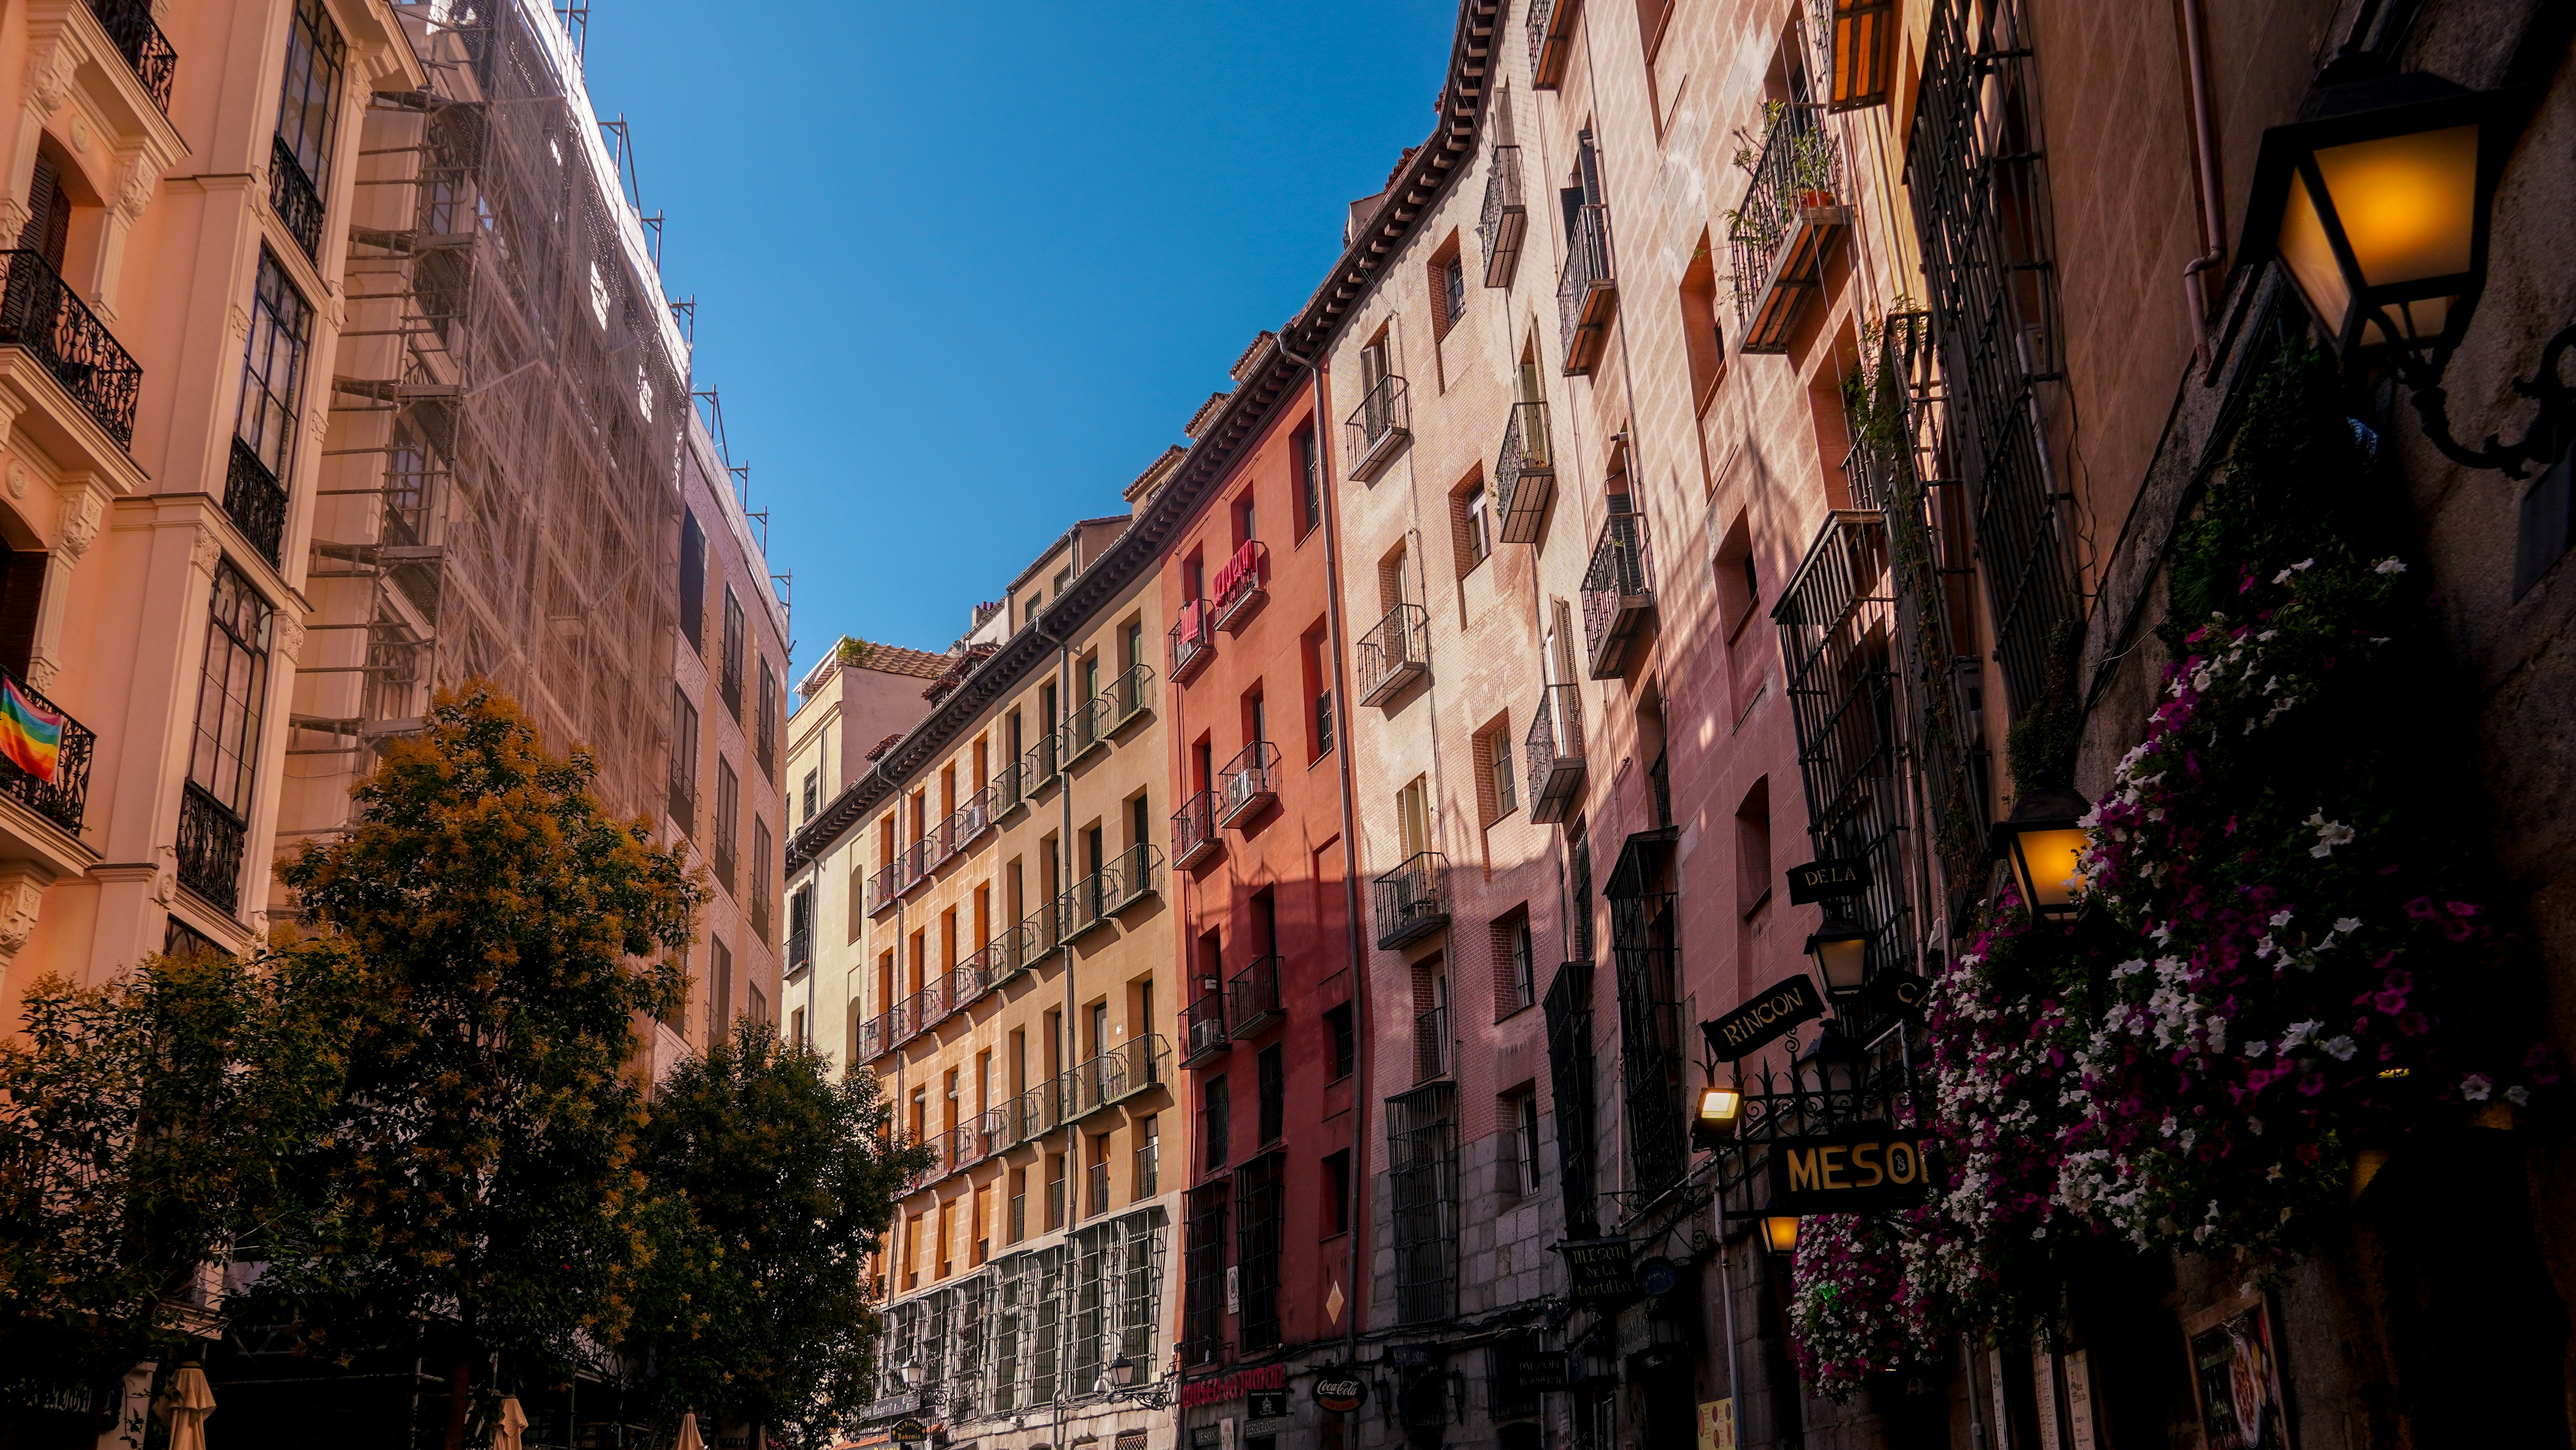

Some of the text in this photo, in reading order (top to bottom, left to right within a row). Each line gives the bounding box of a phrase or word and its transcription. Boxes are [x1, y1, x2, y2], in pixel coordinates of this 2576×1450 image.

[1805, 866, 1857, 887] DE LA
[1722, 987, 1804, 1047] RINCON
[1245, 1420, 1276, 1436] RESTAURANTE
[897, 1433, 921, 1441] Bohemia
[1195, 1430, 1216, 1444] MESON
